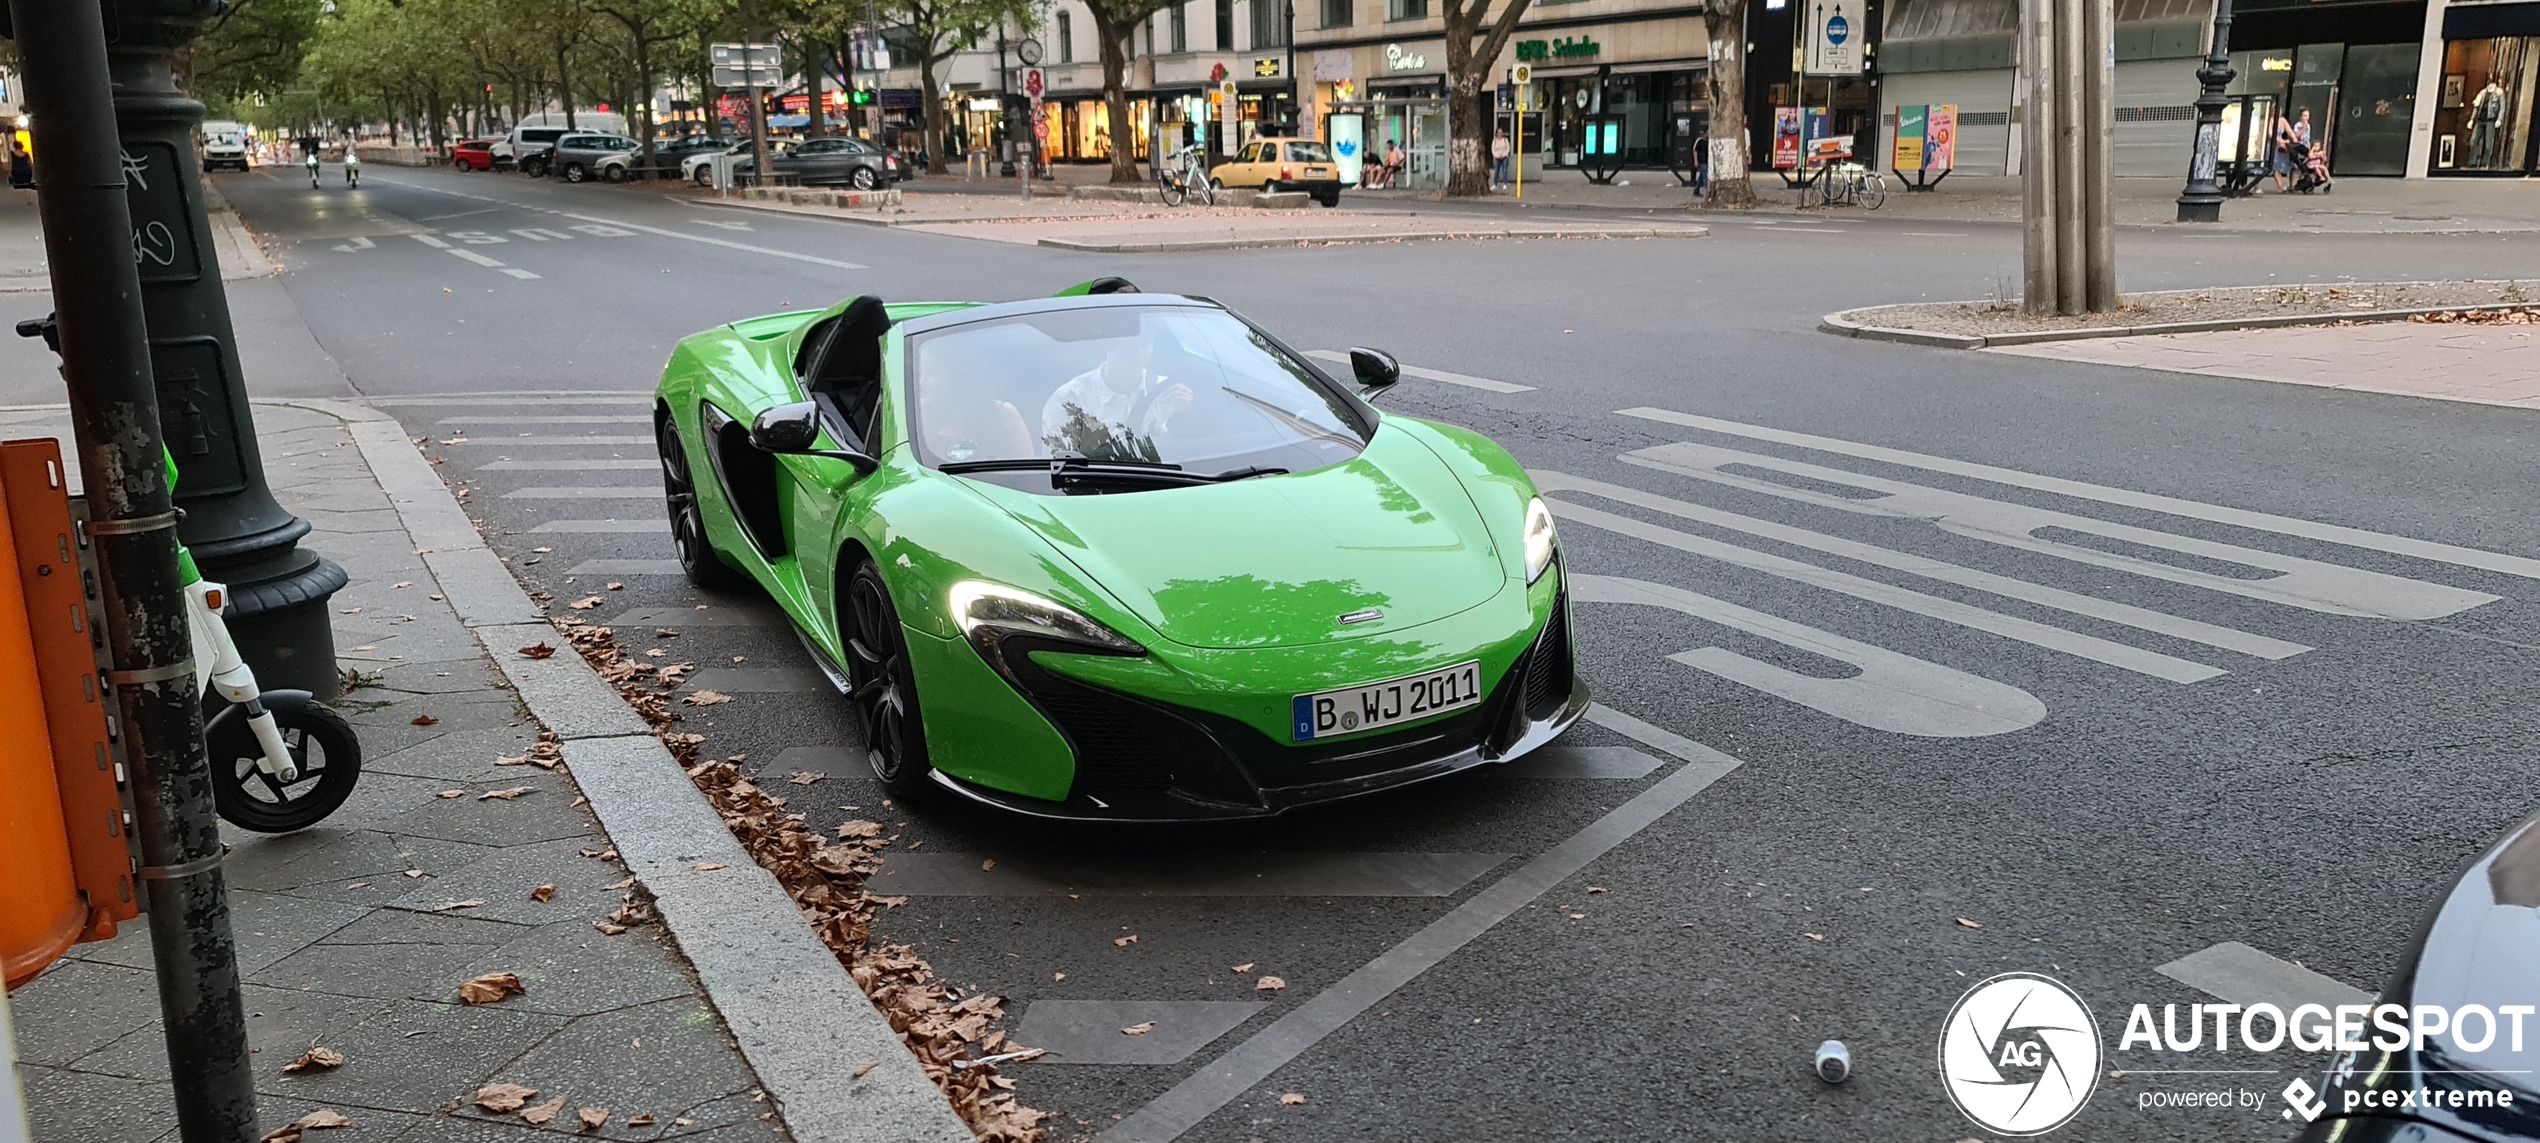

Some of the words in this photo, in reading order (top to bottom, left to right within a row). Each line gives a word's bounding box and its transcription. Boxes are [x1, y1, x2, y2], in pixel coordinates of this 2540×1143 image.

[1316, 698, 1338, 731] B
[1361, 686, 1401, 723] WJ
[1410, 668, 1478, 714] 2011
[1301, 723, 1309, 732] D
